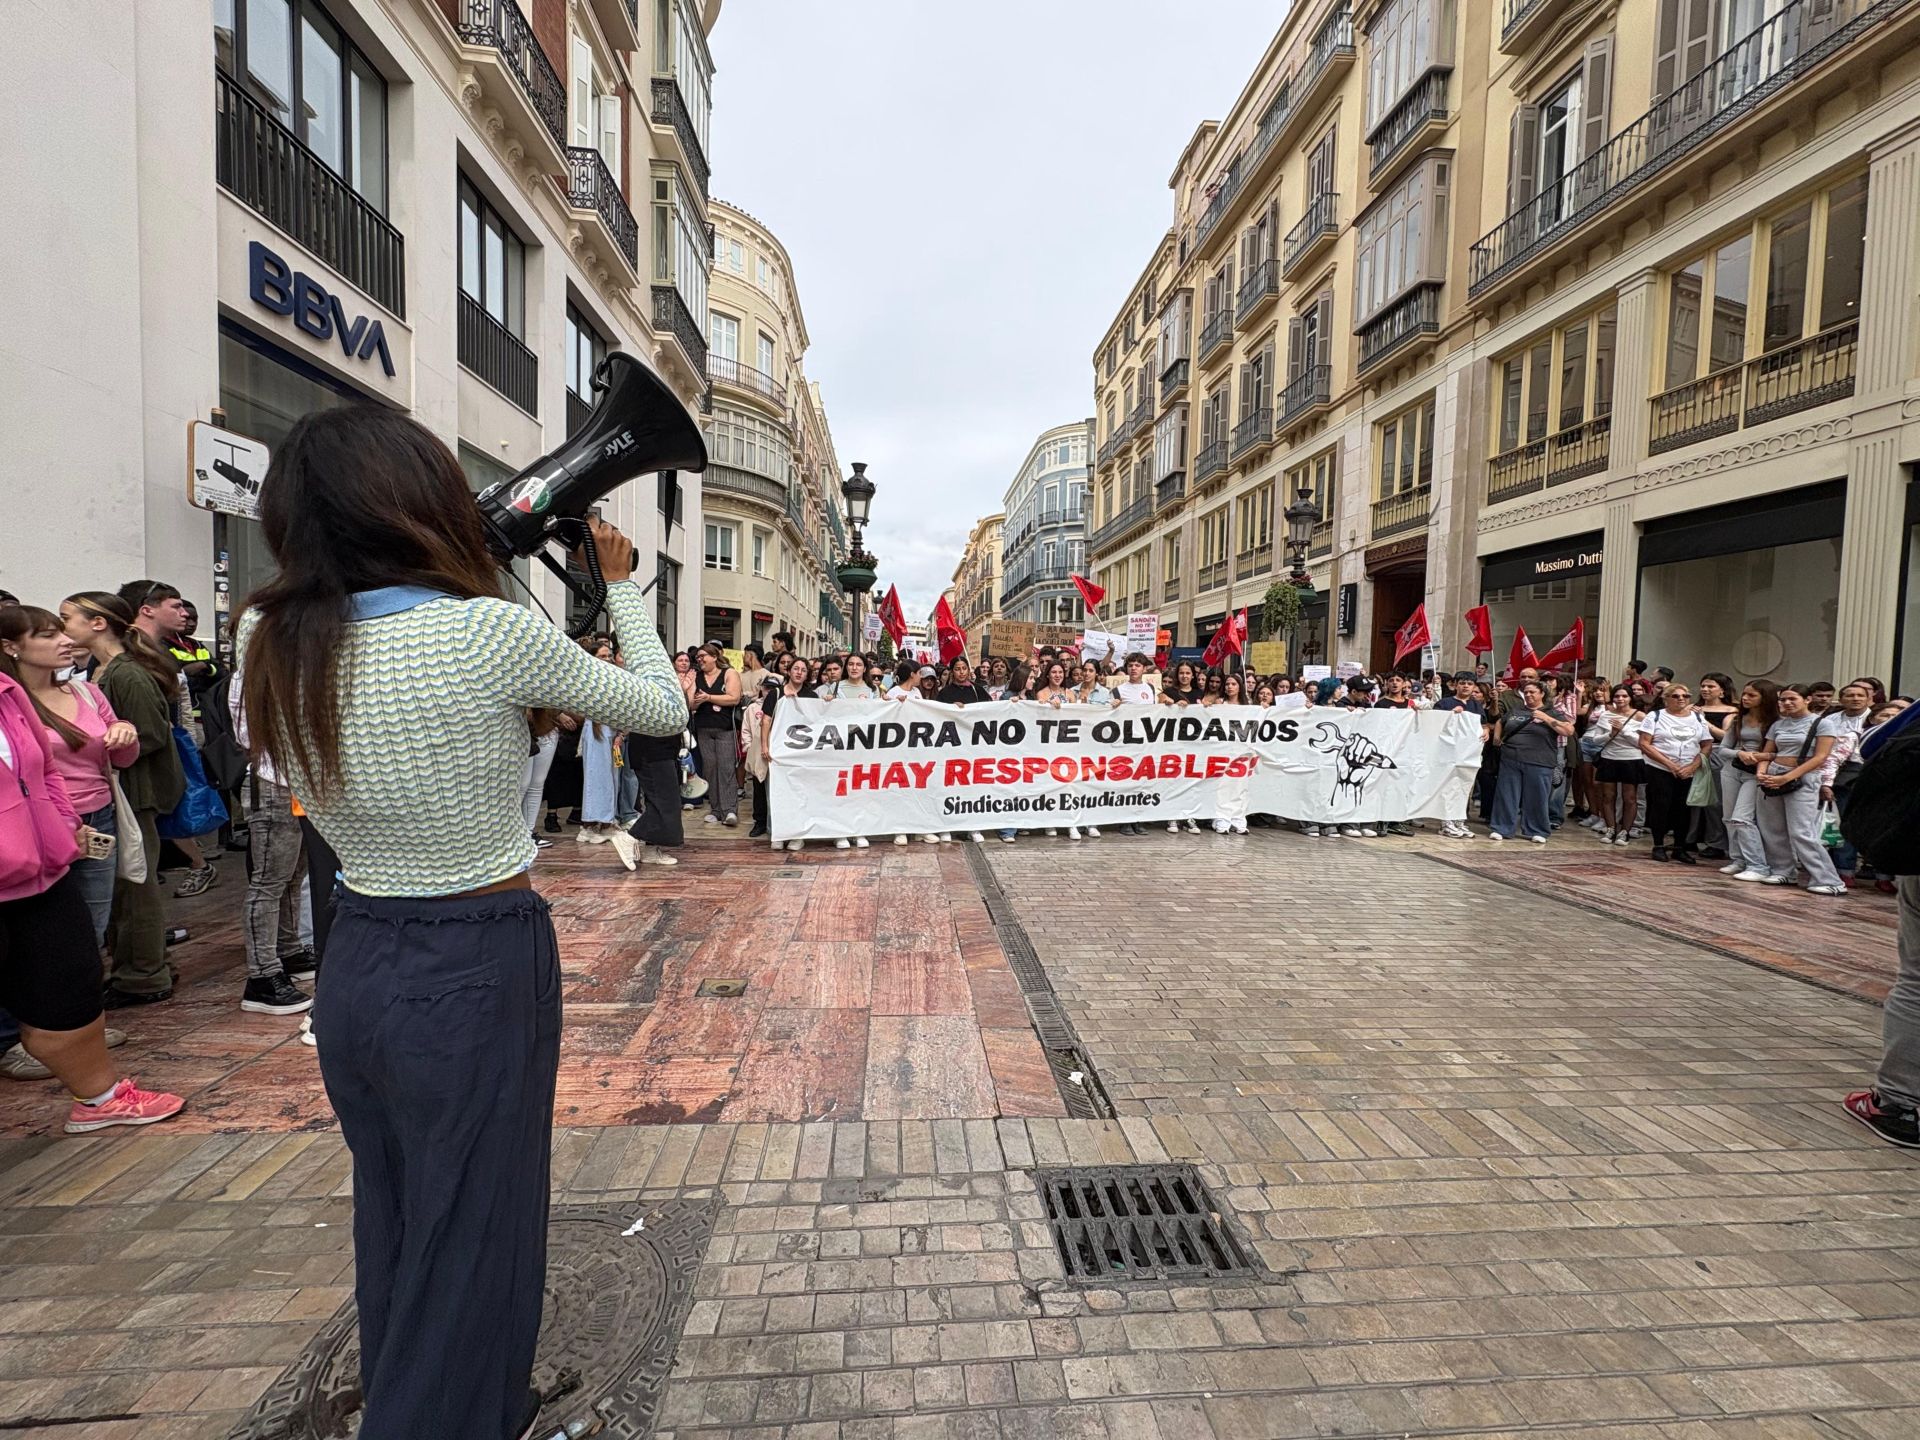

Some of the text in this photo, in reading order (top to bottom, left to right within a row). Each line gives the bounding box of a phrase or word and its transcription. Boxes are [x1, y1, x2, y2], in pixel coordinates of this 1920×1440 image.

[249, 241, 396, 377] BBVA
[1535, 550, 1603, 573] Massimo Dutti
[784, 717, 1299, 750] SANDRA NO TE OLVIDAMOS
[835, 754, 1260, 796] ¡HAY RESPONSABLES!
[943, 791, 1160, 815] Sindicato de Estudiantes
